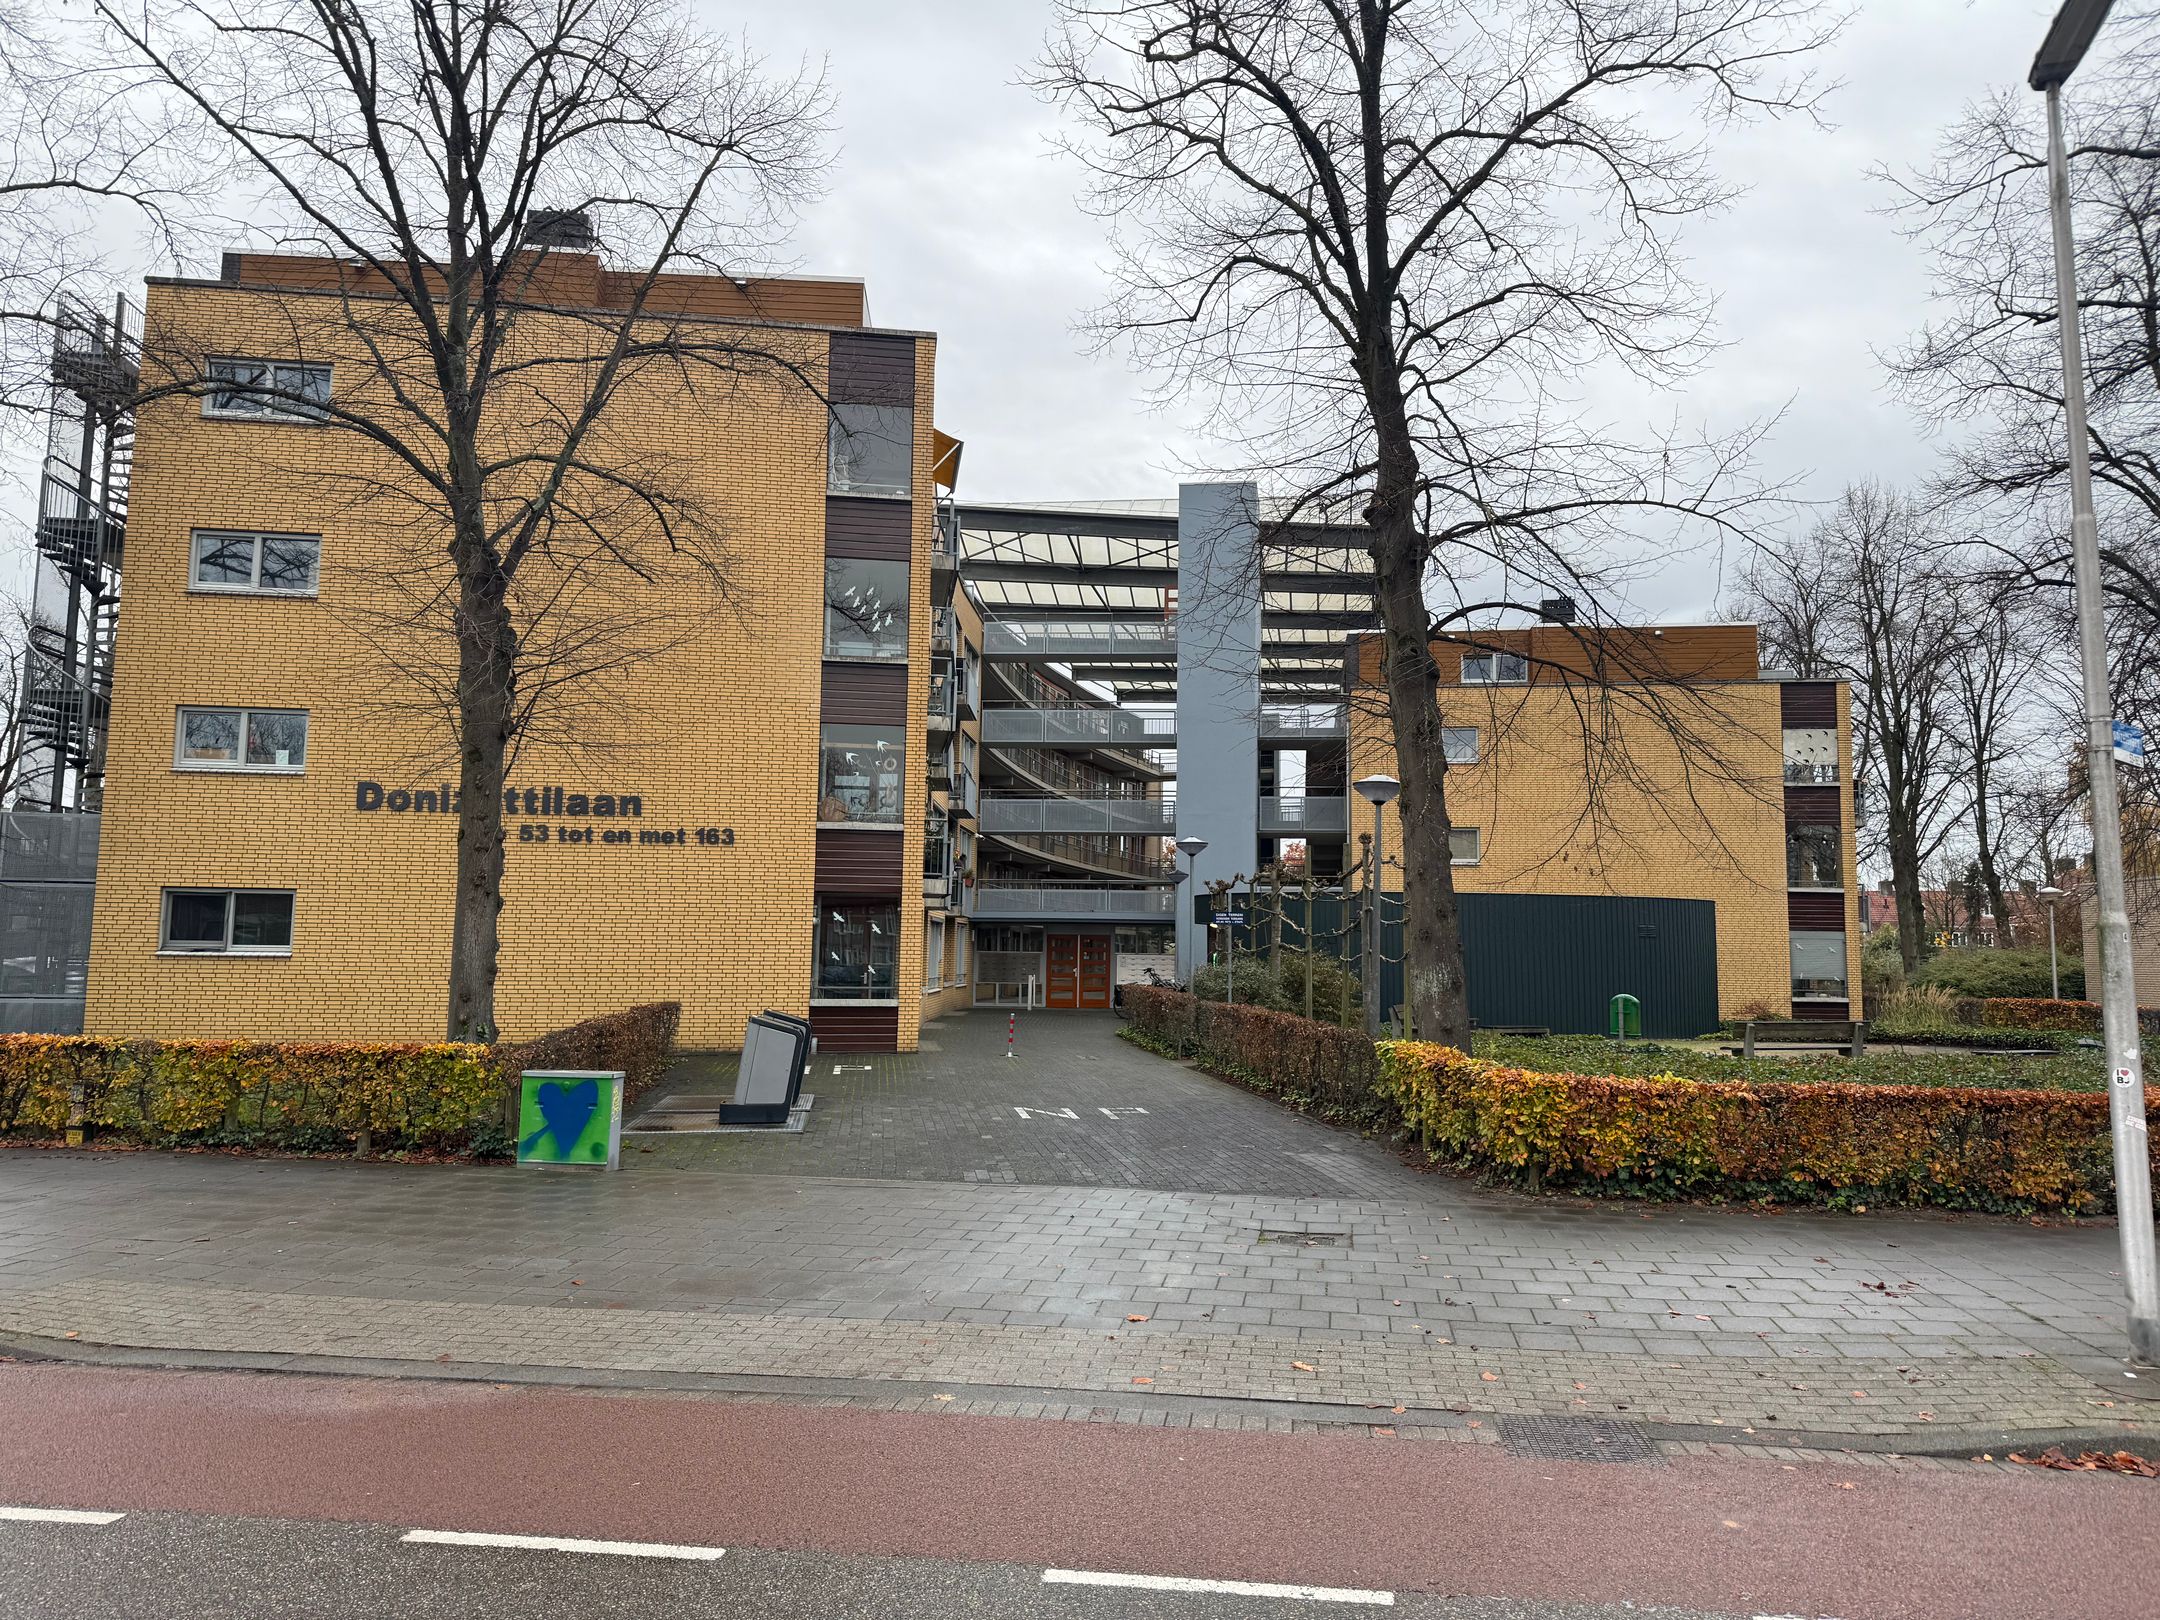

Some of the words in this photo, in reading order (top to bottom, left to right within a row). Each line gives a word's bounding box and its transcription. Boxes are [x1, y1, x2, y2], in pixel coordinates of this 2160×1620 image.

[356, 781, 642, 816] Donittilaan
[520, 824, 549, 841] 53
[558, 825, 594, 842] tot
[602, 829, 631, 843] en
[640, 827, 686, 844] met
[695, 827, 735, 846] 163
